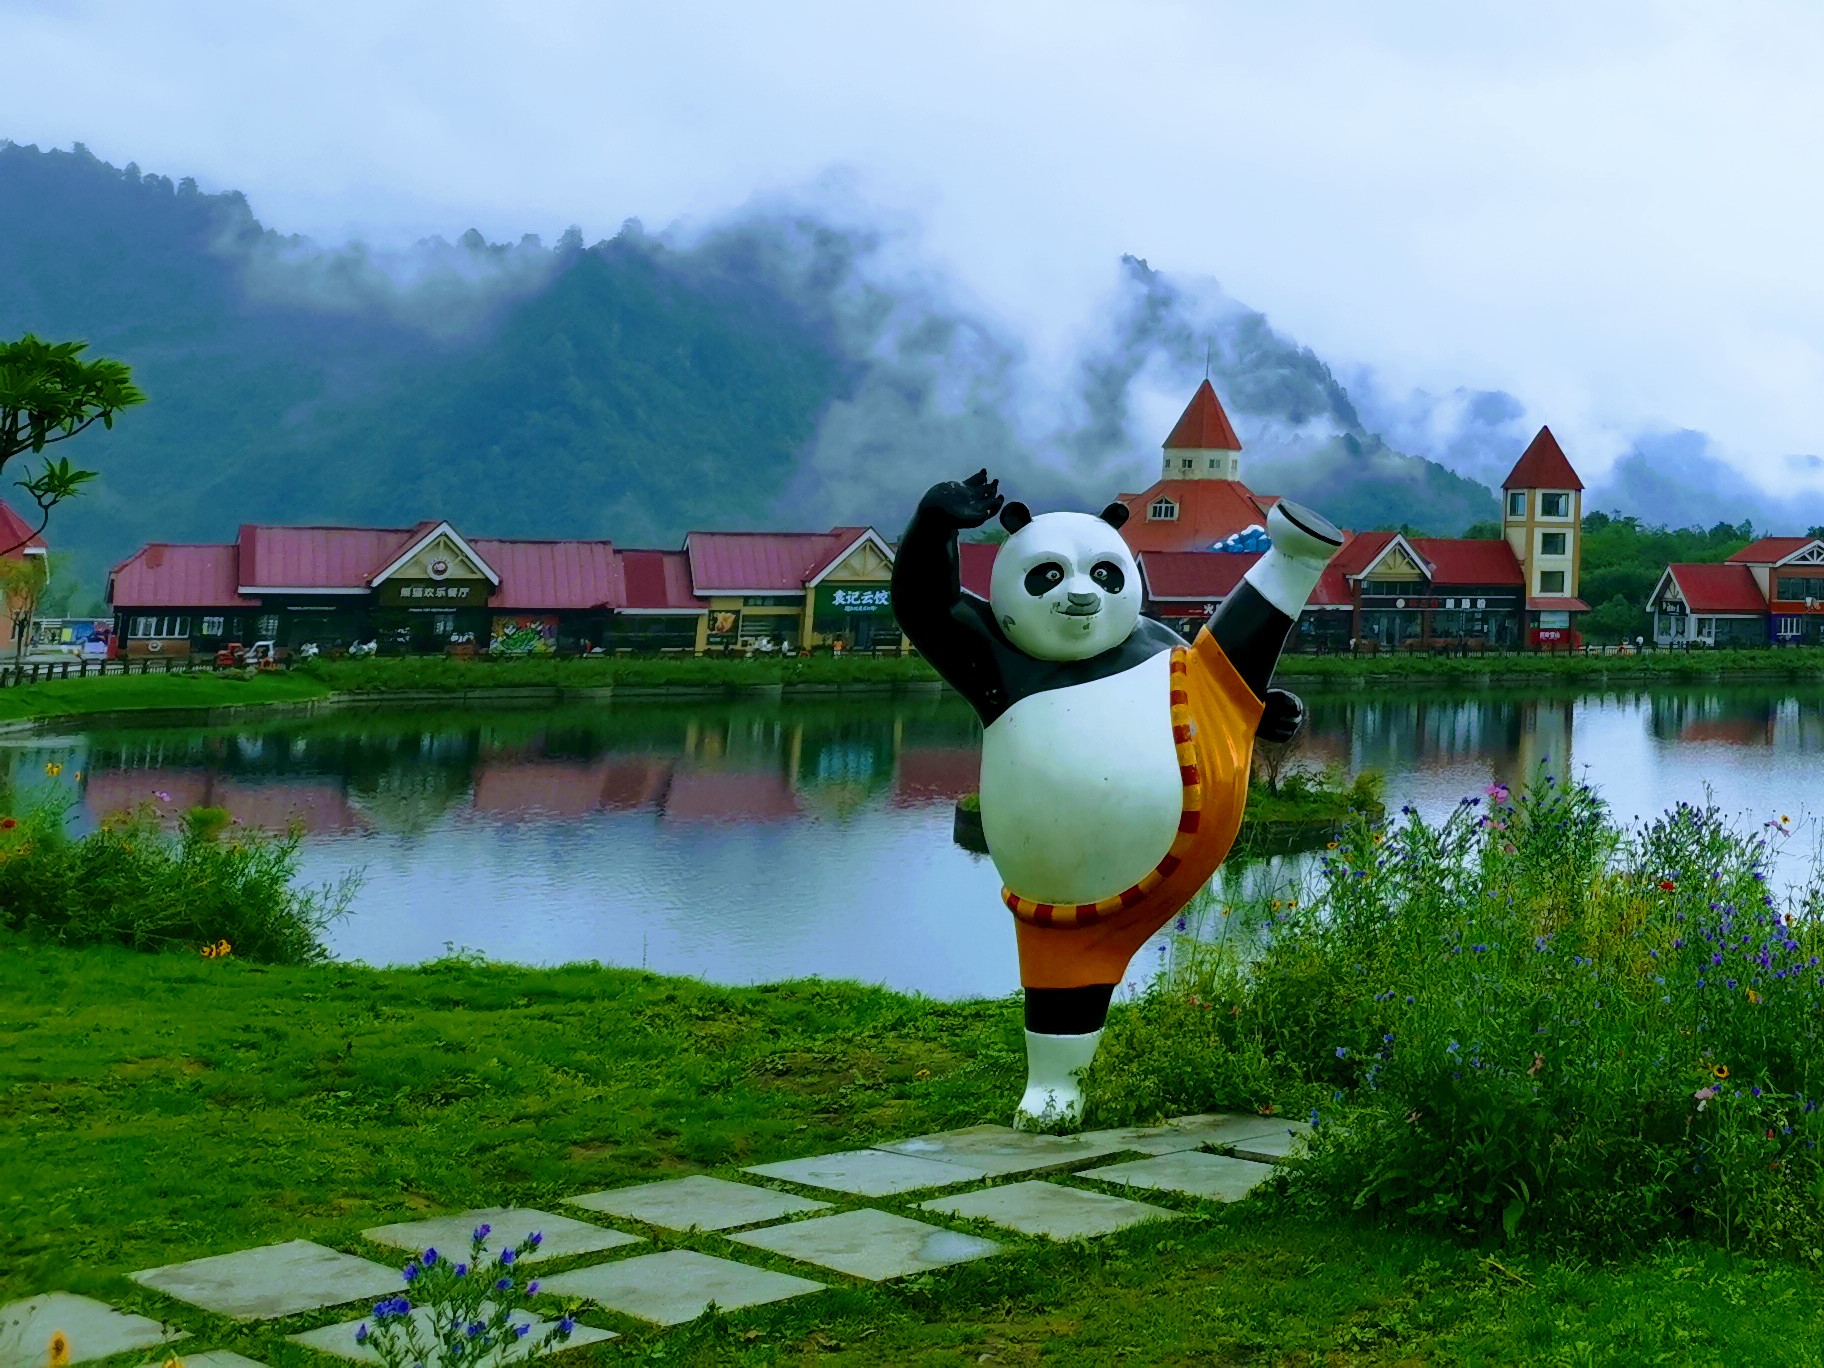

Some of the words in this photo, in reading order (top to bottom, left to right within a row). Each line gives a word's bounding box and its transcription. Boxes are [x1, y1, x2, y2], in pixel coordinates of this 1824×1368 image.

[401, 587, 470, 598] 熊猫欢乐餐厅
[832, 590, 889, 605] 袁记云饺
